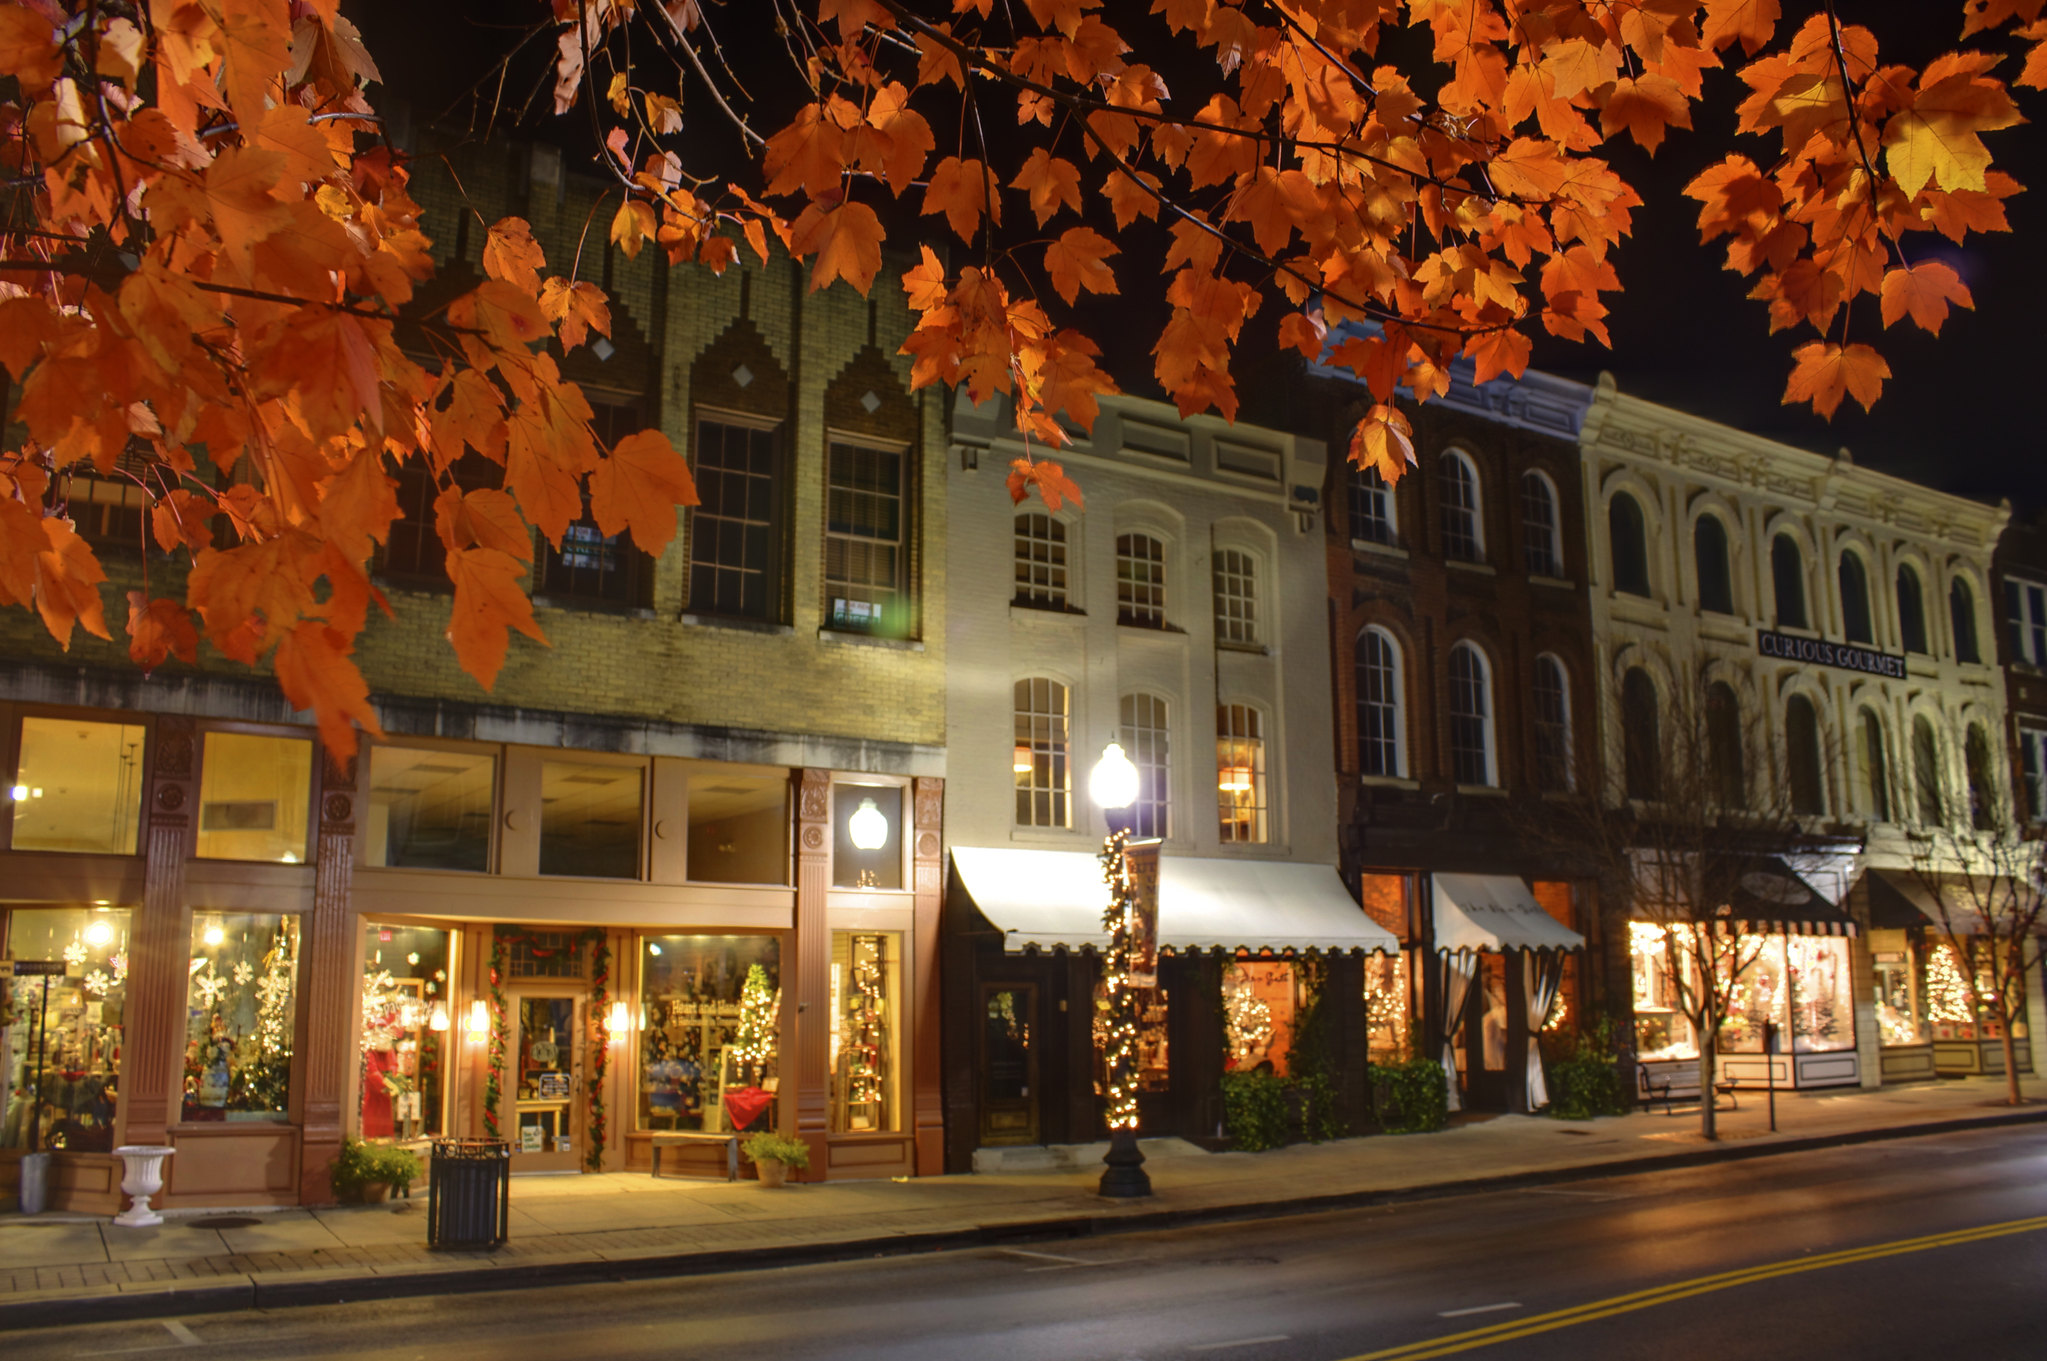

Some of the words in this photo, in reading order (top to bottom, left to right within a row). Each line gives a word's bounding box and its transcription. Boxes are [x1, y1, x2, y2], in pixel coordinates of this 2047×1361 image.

[1760, 633, 1834, 665] CURIOUS
[1836, 647, 1904, 677] GOURMET
[672, 999, 697, 1015] Heart
[698, 999, 716, 1015] and
